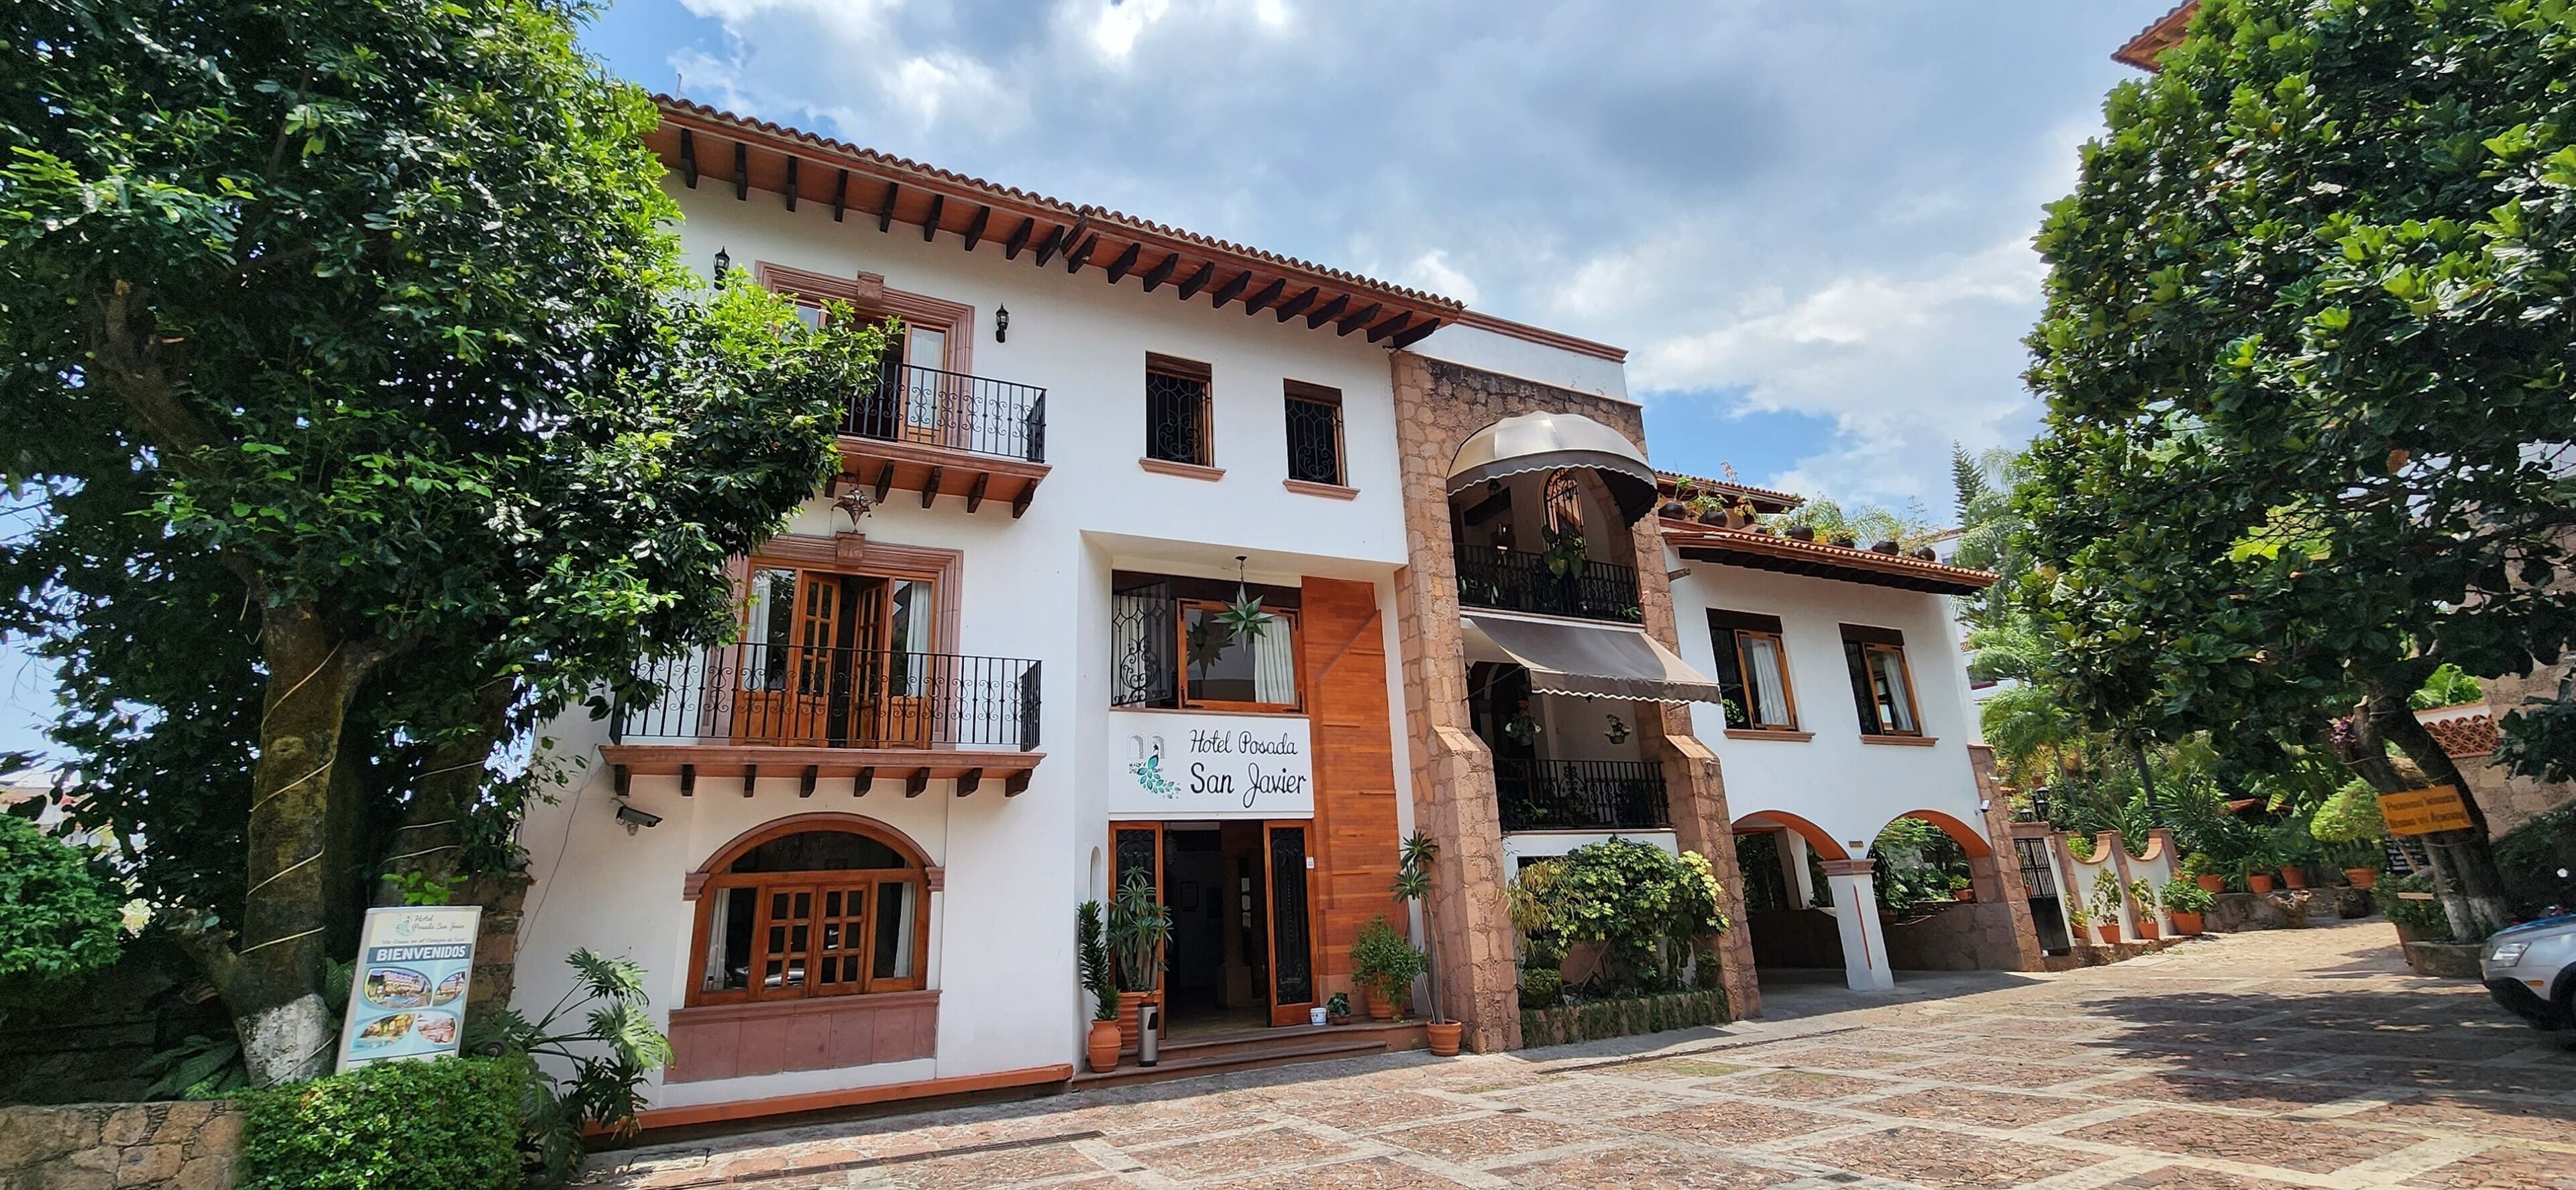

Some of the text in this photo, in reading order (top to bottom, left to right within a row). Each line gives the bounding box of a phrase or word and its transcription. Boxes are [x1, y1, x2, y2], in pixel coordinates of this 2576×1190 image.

[1189, 729, 1298, 755] Hotel Posada
[1190, 762, 1307, 809] San Javier
[376, 945, 466, 961] BIENVENIDOS
